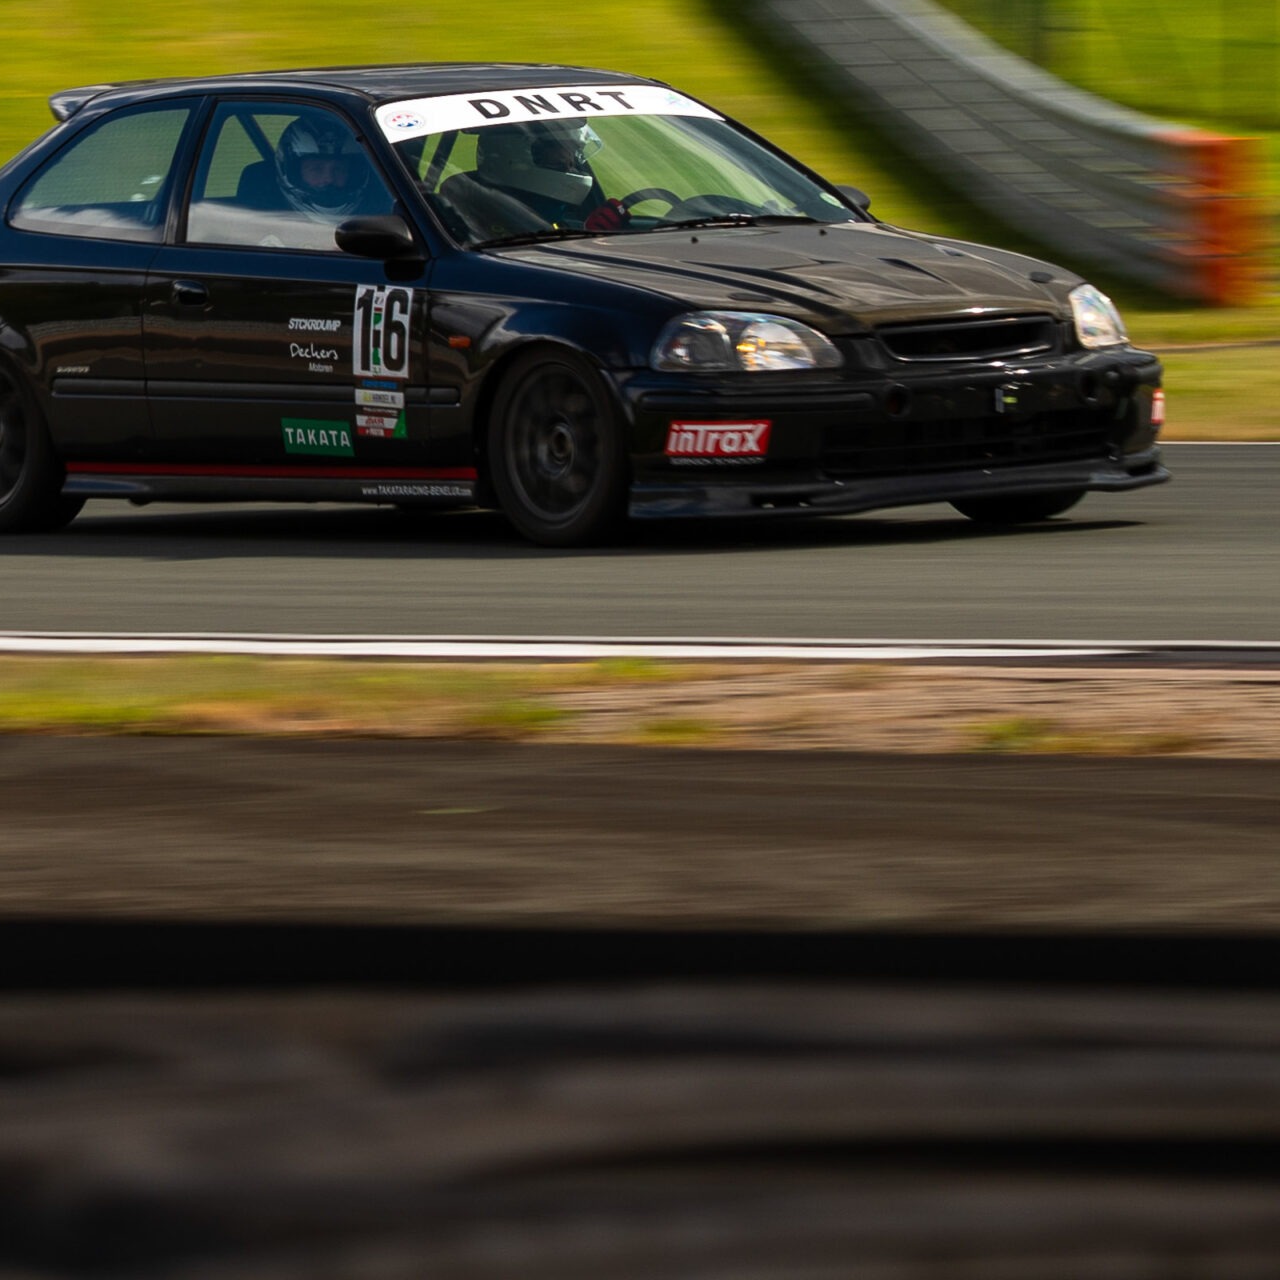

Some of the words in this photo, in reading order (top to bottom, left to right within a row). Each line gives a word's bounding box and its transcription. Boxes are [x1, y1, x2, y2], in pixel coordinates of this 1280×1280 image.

[468, 91, 634, 119] DNRT
[357, 288, 409, 372] 16
[285, 427, 351, 448] TAKATA
